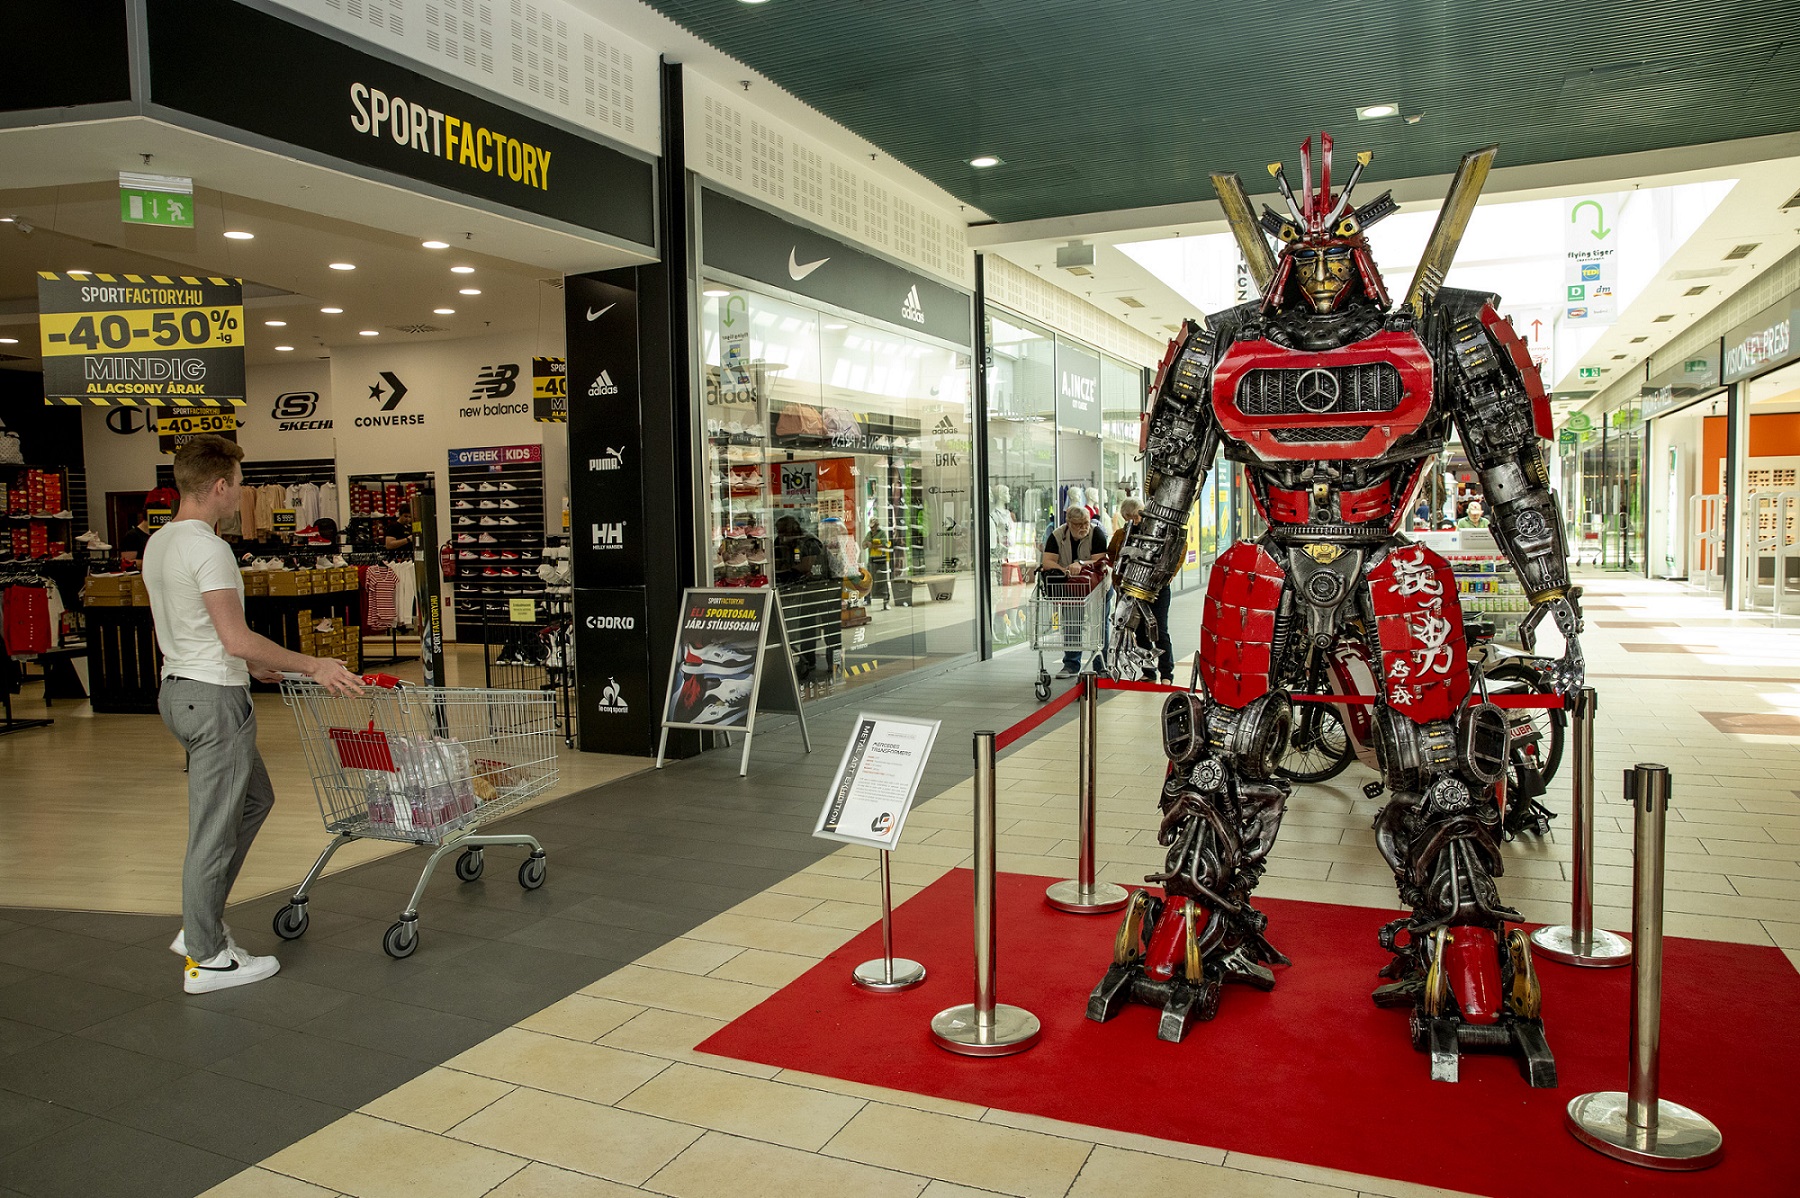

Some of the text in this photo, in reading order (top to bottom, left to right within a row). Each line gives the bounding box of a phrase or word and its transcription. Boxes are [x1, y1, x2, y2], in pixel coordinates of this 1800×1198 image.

[350, 82, 551, 191] SPORTFACTORY
[1568, 249, 1614, 259] flying tiger
[81, 286, 203, 305] SPORTFACTORY.HU
[1596, 285, 1611, 293] dm
[902, 306, 924, 324] adidas
[1725, 340, 1749, 376] VISION
[84, 356, 206, 381] MINDIG
[86, 381, 205, 394] ALACSONY ÁRAK
[588, 385, 618, 396] adidas
[460, 403, 529, 418] new balance
[355, 414, 425, 427] CONVERSE
[932, 426, 958, 434] adidas
[459, 449, 530, 462] GYEREK KIDS
[592, 523, 623, 544] HH
[690, 606, 757, 620] ÉLJ SPORTOSAN,
[685, 618, 760, 631] JÁRJ STÍLUSOSAN!
[871, 748, 912, 757] TRANSFORMERS
[829, 725, 871, 824] METAL ART EXHIBITION
